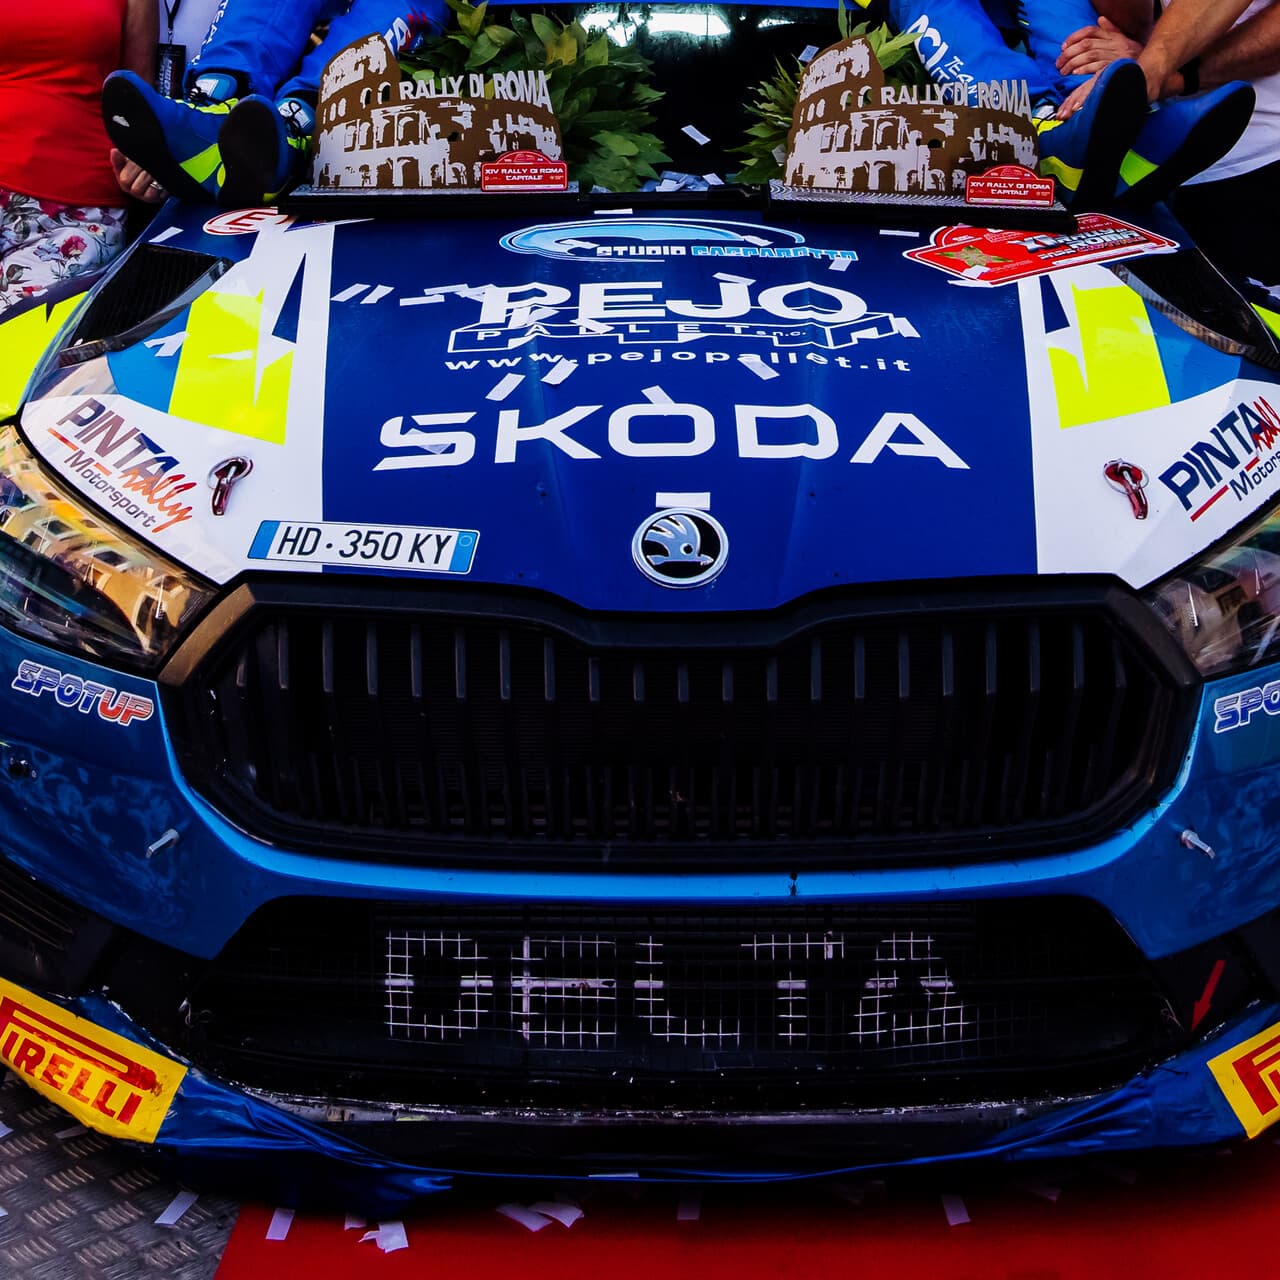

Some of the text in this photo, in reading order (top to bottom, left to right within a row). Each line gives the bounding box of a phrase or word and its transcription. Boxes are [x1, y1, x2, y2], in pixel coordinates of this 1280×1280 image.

[399, 70, 554, 114] RALLY DI ROMA
[881, 83, 953, 106] RALLY
[953, 82, 969, 107] DI
[977, 79, 1033, 121] ROMA
[991, 188, 1030, 196] CAPITALE
[596, 246, 687, 256] STUDIO
[480, 281, 868, 324] PEJO
[477, 323, 750, 340] PALLET
[446, 348, 912, 373] www.pejopallet.it
[56, 397, 180, 489] PINTA
[1159, 402, 1265, 511] PINTA
[63, 449, 160, 530] Motorsport
[406, 532, 452, 566] KY
[13, 658, 154, 727] SPOTUP
[385, 931, 974, 1045] DELTA
